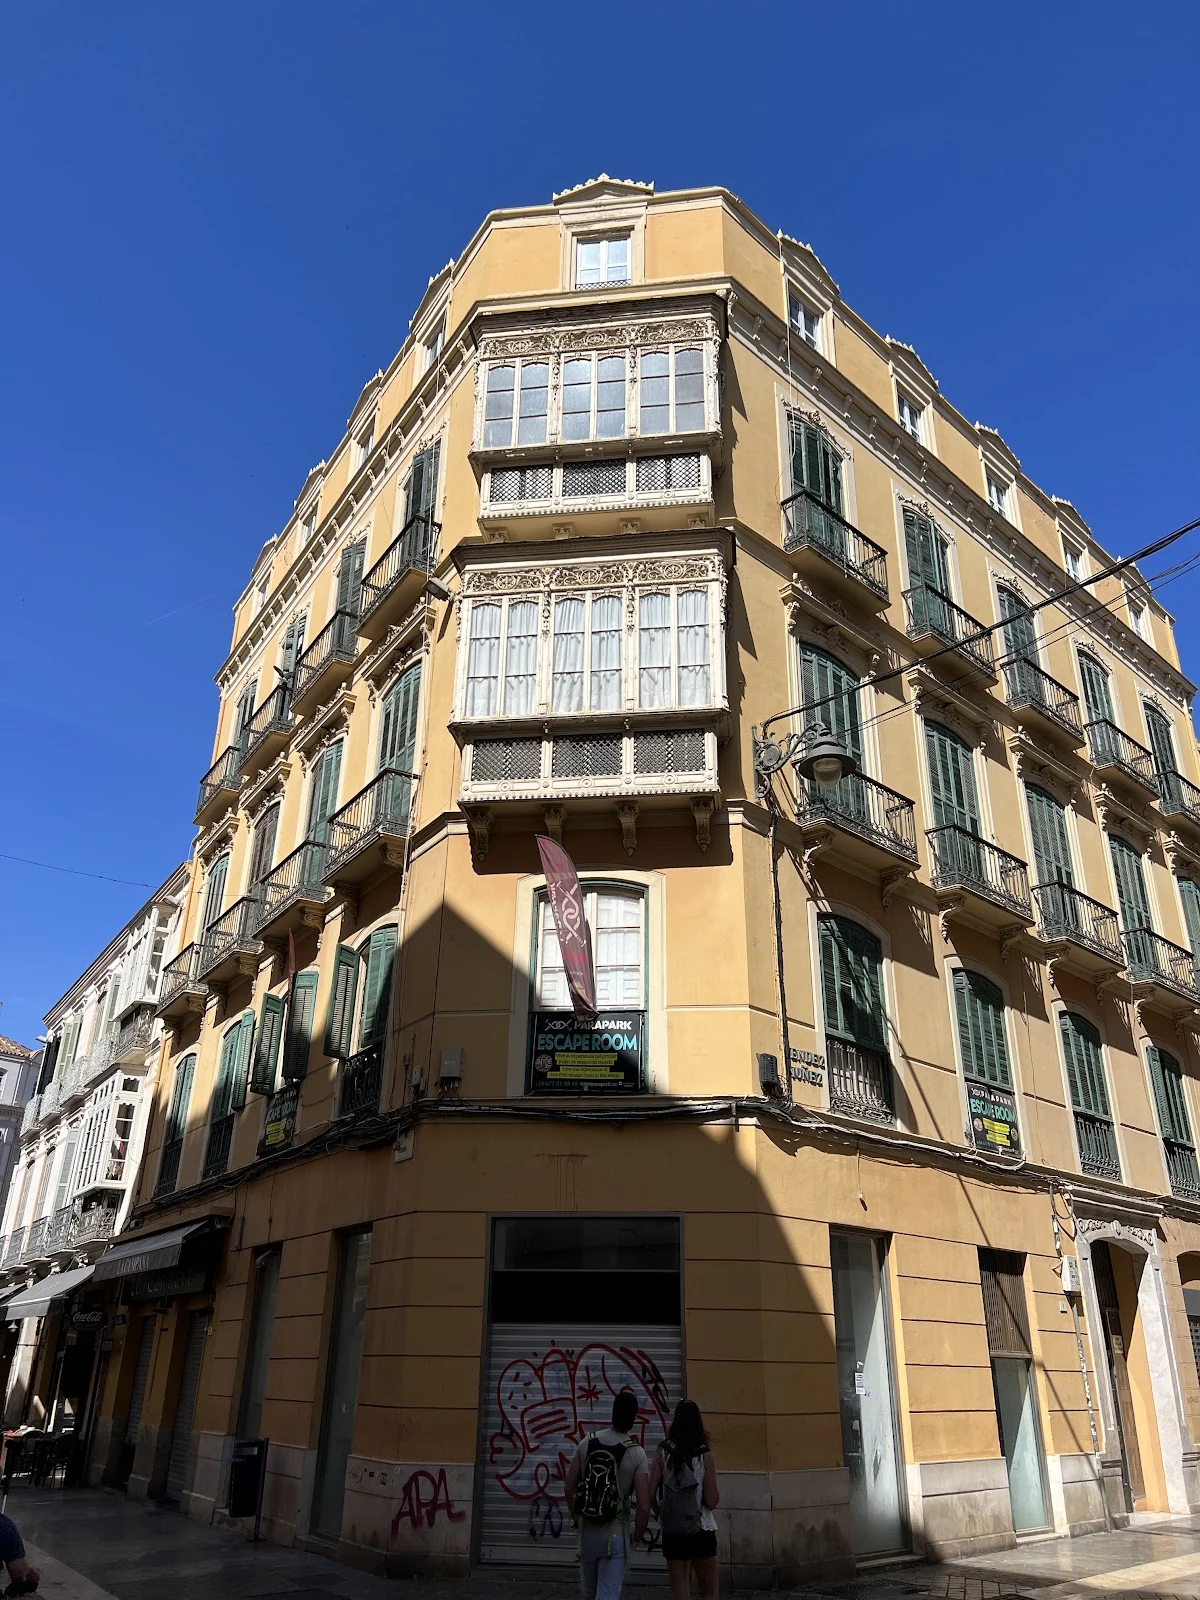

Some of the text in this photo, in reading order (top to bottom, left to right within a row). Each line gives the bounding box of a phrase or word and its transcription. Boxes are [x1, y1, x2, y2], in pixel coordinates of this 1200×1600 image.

[573, 1020, 633, 1031] PARAPARK
[537, 1033, 638, 1051] ESCAPE ROOM
[789, 1048, 825, 1068] ENDEZ
[994, 1105, 1018, 1124] ROOM
